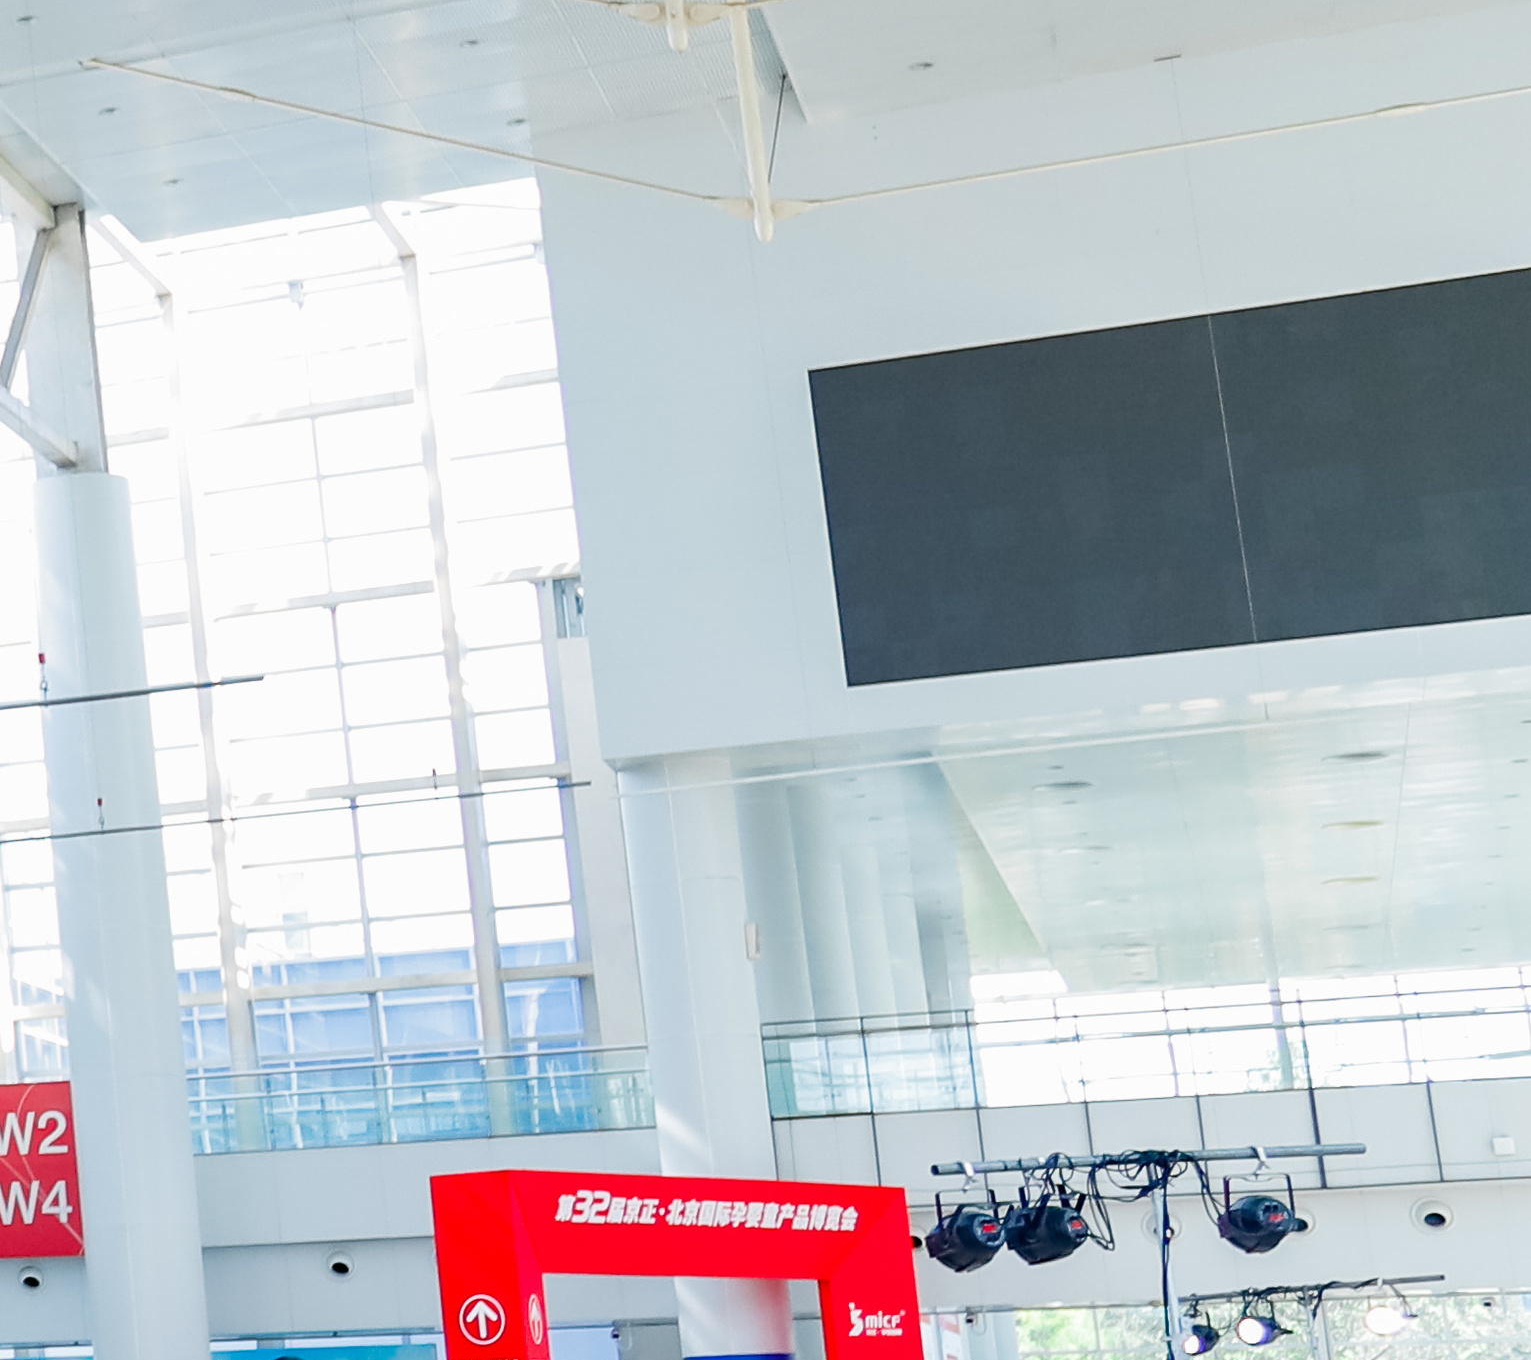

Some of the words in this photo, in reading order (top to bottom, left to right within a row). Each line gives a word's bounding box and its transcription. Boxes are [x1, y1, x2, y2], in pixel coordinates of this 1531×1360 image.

[555, 1189, 859, 1232] 第32届京正·北京国际孕婴童产品博览会
